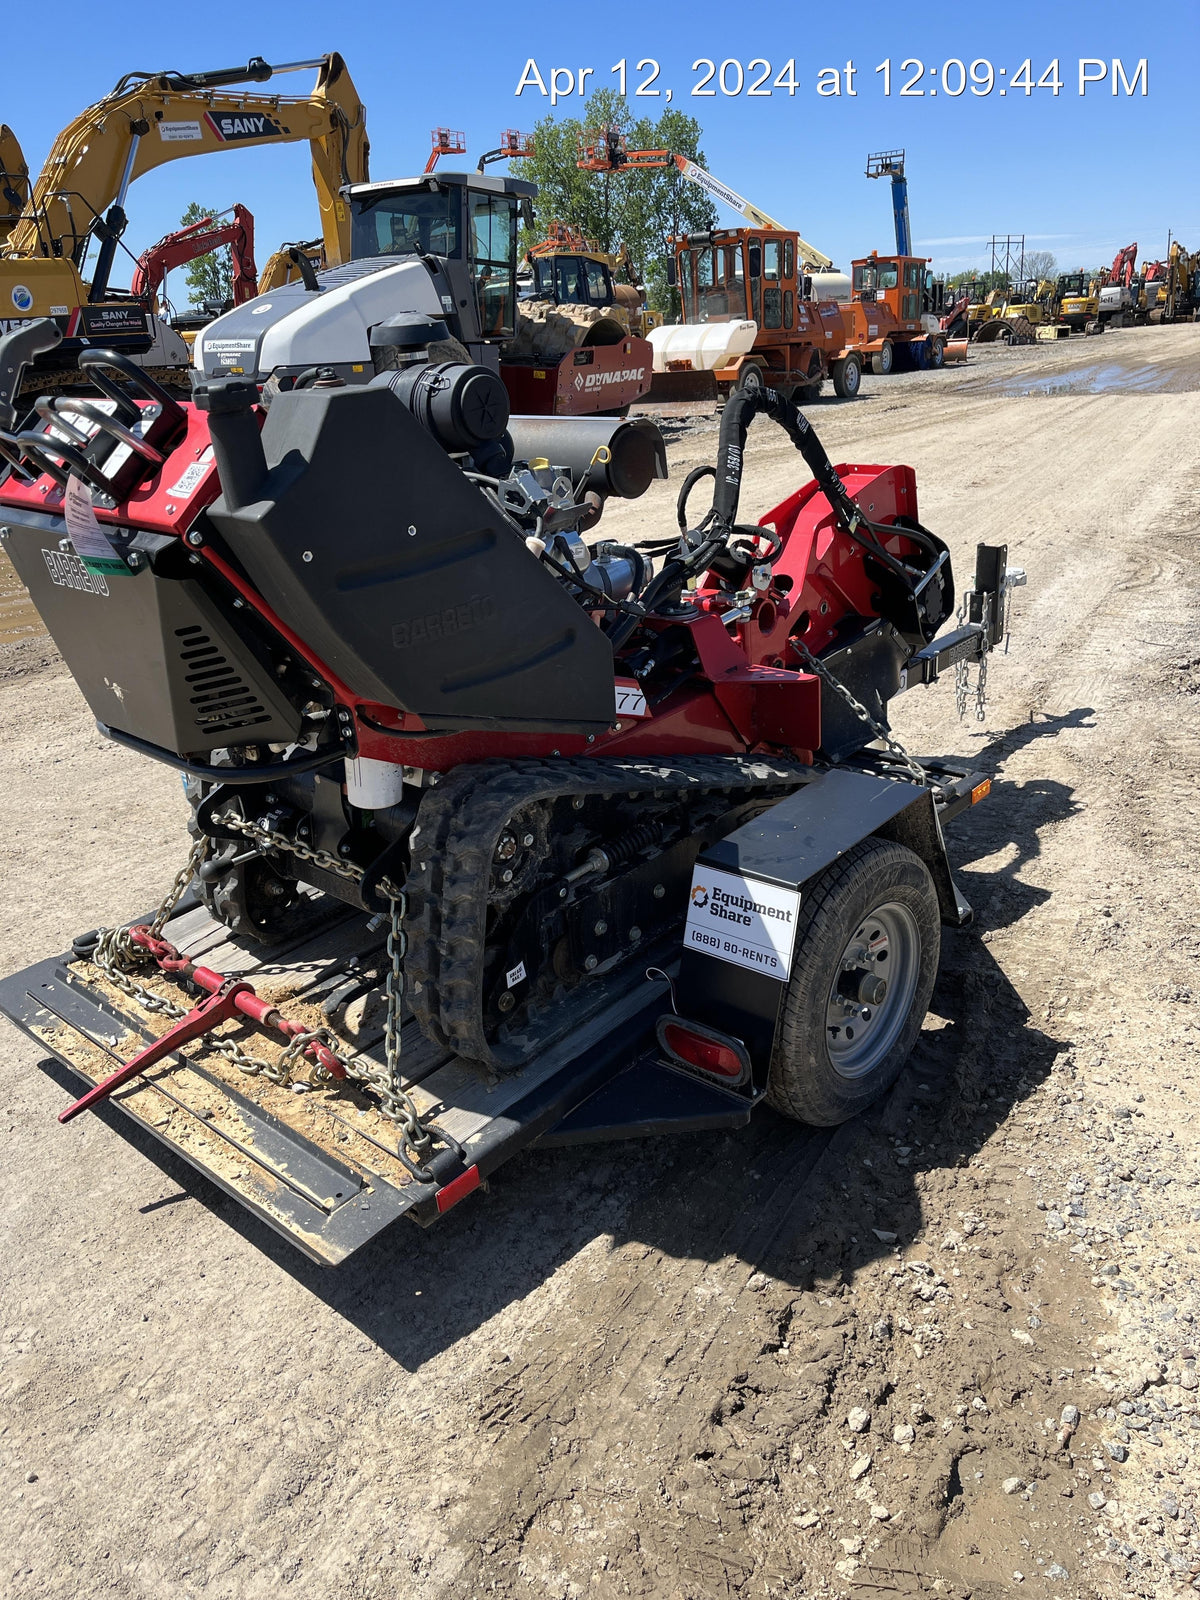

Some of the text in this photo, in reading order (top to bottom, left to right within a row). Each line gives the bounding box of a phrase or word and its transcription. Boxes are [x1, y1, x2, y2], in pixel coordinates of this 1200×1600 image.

[220, 117, 265, 134] SANY
[696, 173, 743, 209] EquipmentShare
[102, 311, 129, 320] SANY
[212, 342, 251, 350] EquipmentShare
[585, 367, 645, 387] DYNAPAC
[617, 692, 644, 711] 77
[709, 902, 752, 926] Share
[712, 886, 792, 923] Equipment
[691, 930, 778, 968] (888) 80-RENTS
